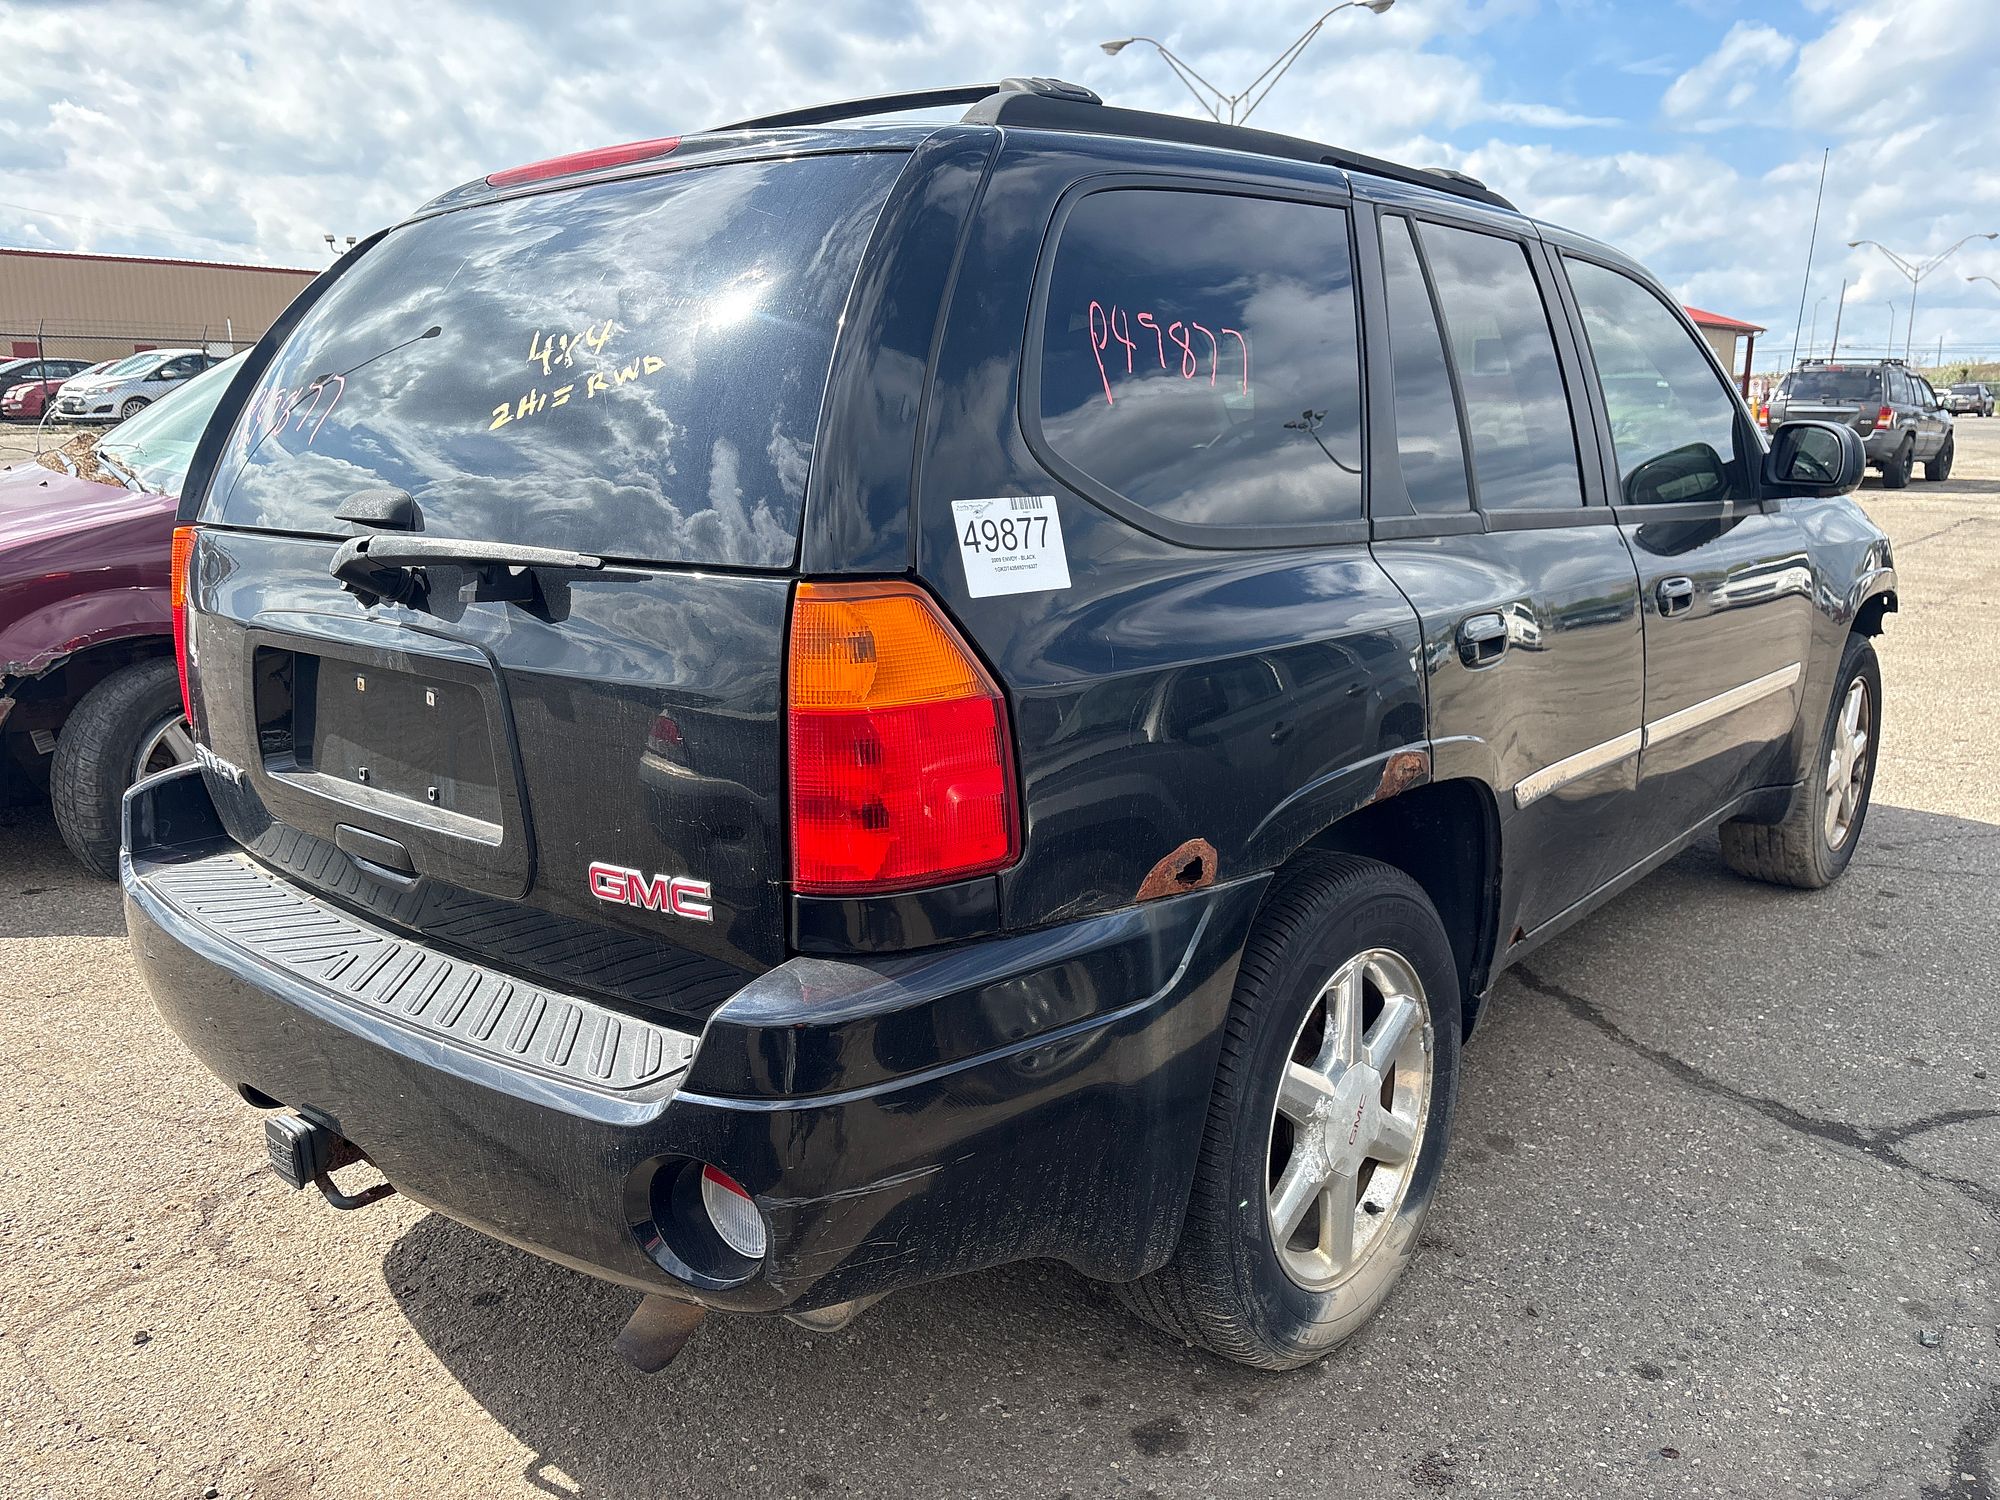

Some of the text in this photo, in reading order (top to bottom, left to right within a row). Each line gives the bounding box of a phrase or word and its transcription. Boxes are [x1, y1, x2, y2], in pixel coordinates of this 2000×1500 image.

[588, 355, 666, 399] RWD
[963, 516, 1049, 553] 49877
[589, 861, 714, 922] GMC
[1349, 1094, 1367, 1145] GMC
